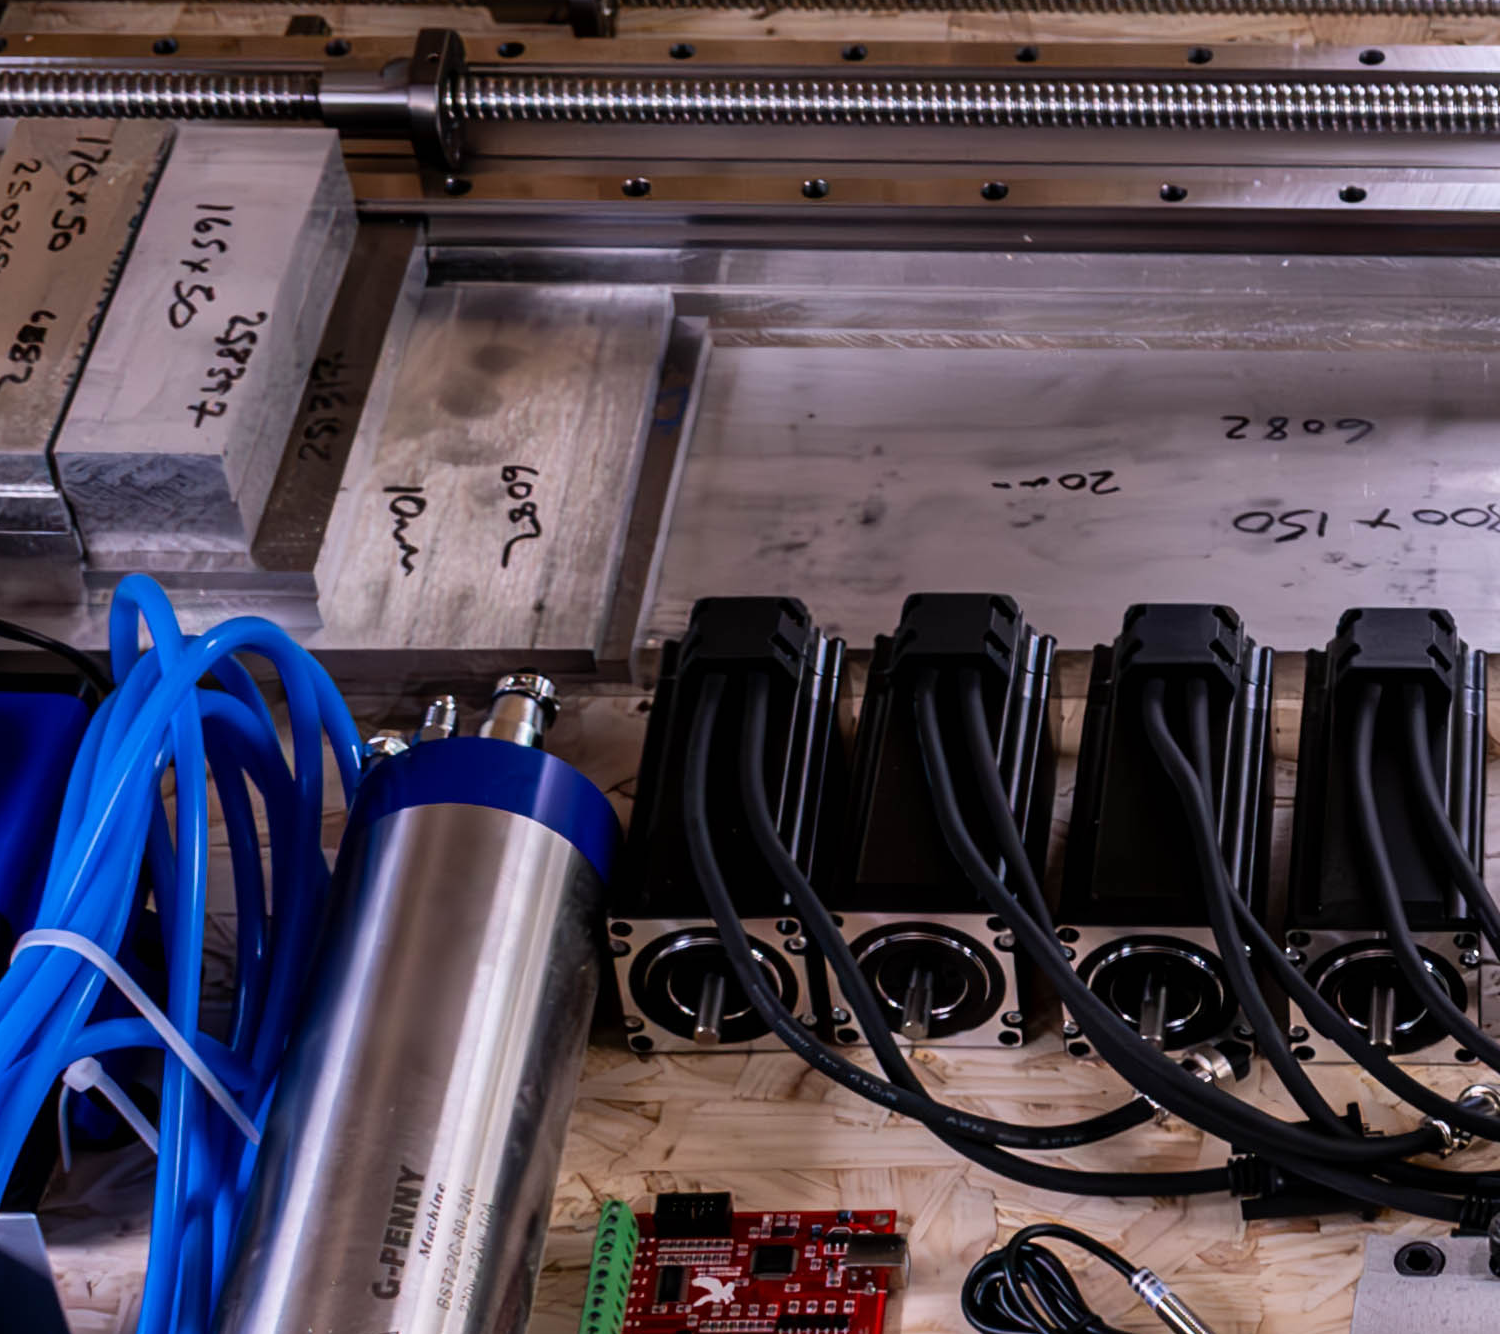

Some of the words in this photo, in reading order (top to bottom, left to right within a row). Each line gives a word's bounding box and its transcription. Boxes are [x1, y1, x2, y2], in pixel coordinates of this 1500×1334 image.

[1221, 415, 1376, 444] 6082
[501, 464, 542, 569] 6082
[1233, 510, 1329, 544] 150
[372, 1165, 425, 1300] G-PENNY
[418, 1182, 447, 1260] Machine
